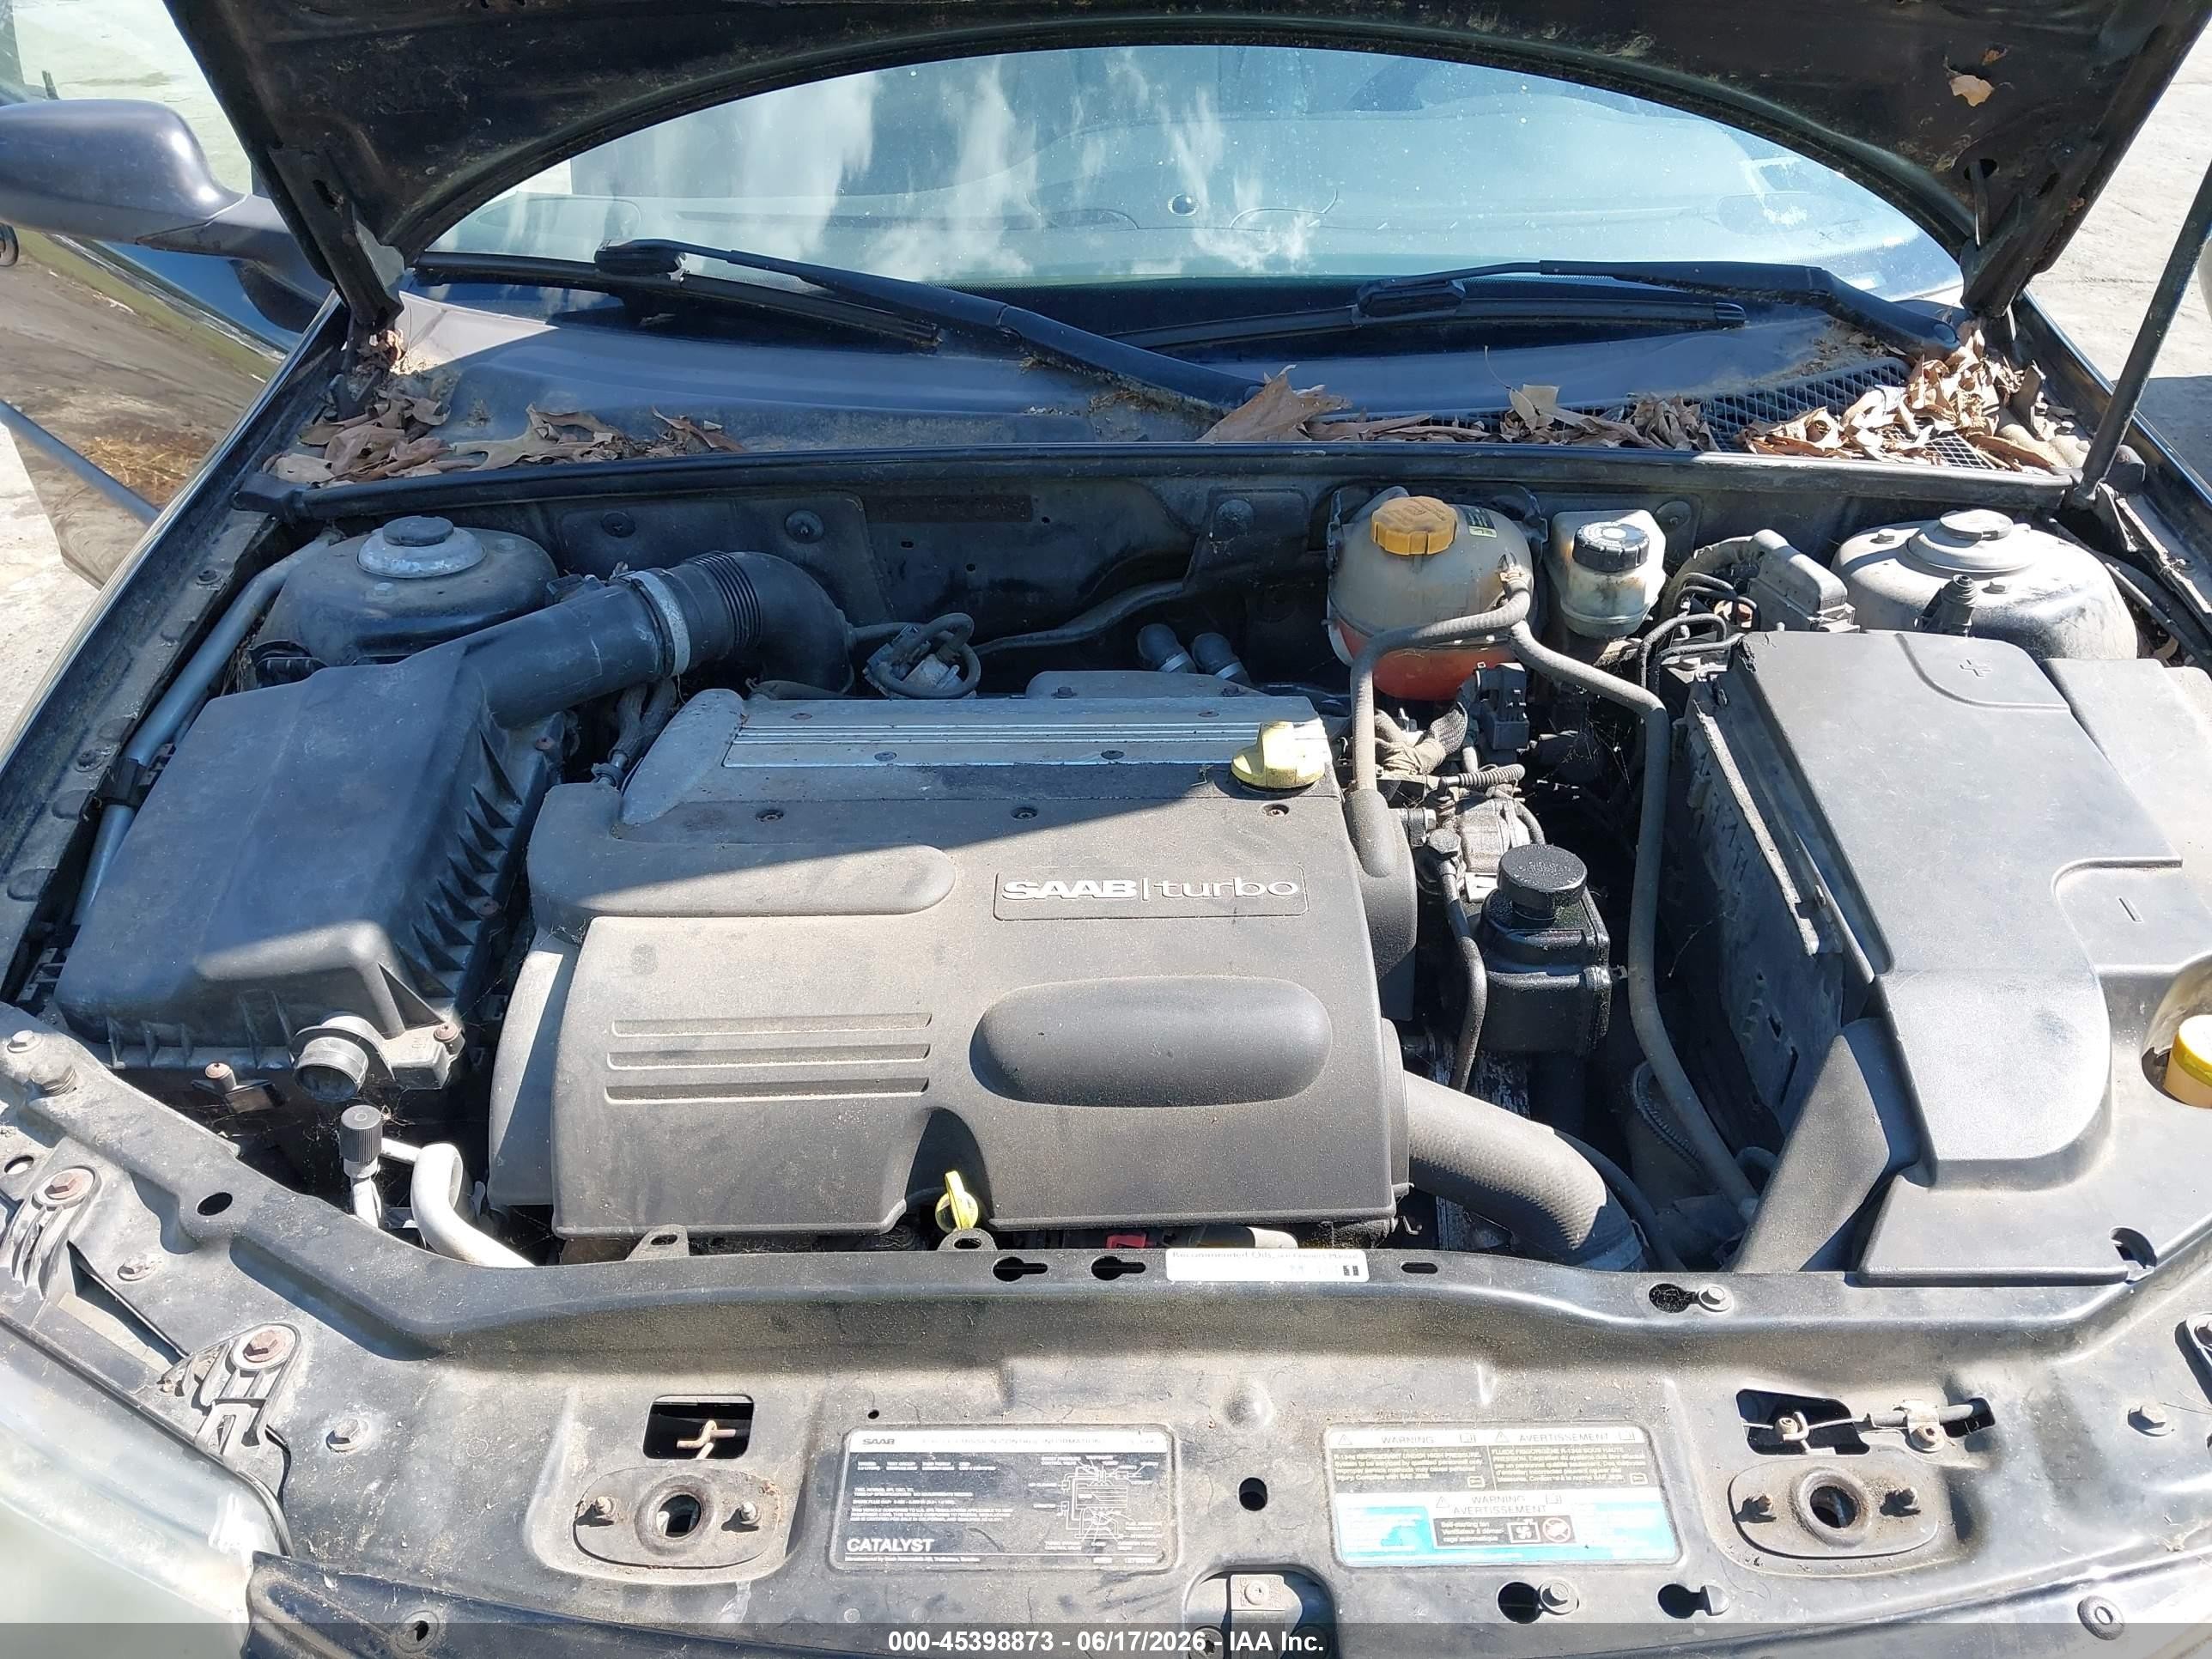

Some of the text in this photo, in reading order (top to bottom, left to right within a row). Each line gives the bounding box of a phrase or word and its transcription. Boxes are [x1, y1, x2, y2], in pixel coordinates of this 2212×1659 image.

[1000, 877, 1299, 900] SAAB turbo
[1381, 1435, 1436, 1444] WARNING
[1519, 1433, 1609, 1443] AVERTISSEMENT
[1471, 1495, 1526, 1504] WARNING
[1453, 1505, 1547, 1515] AVERTISSEMENT
[846, 1538, 935, 1553] CATALYST
